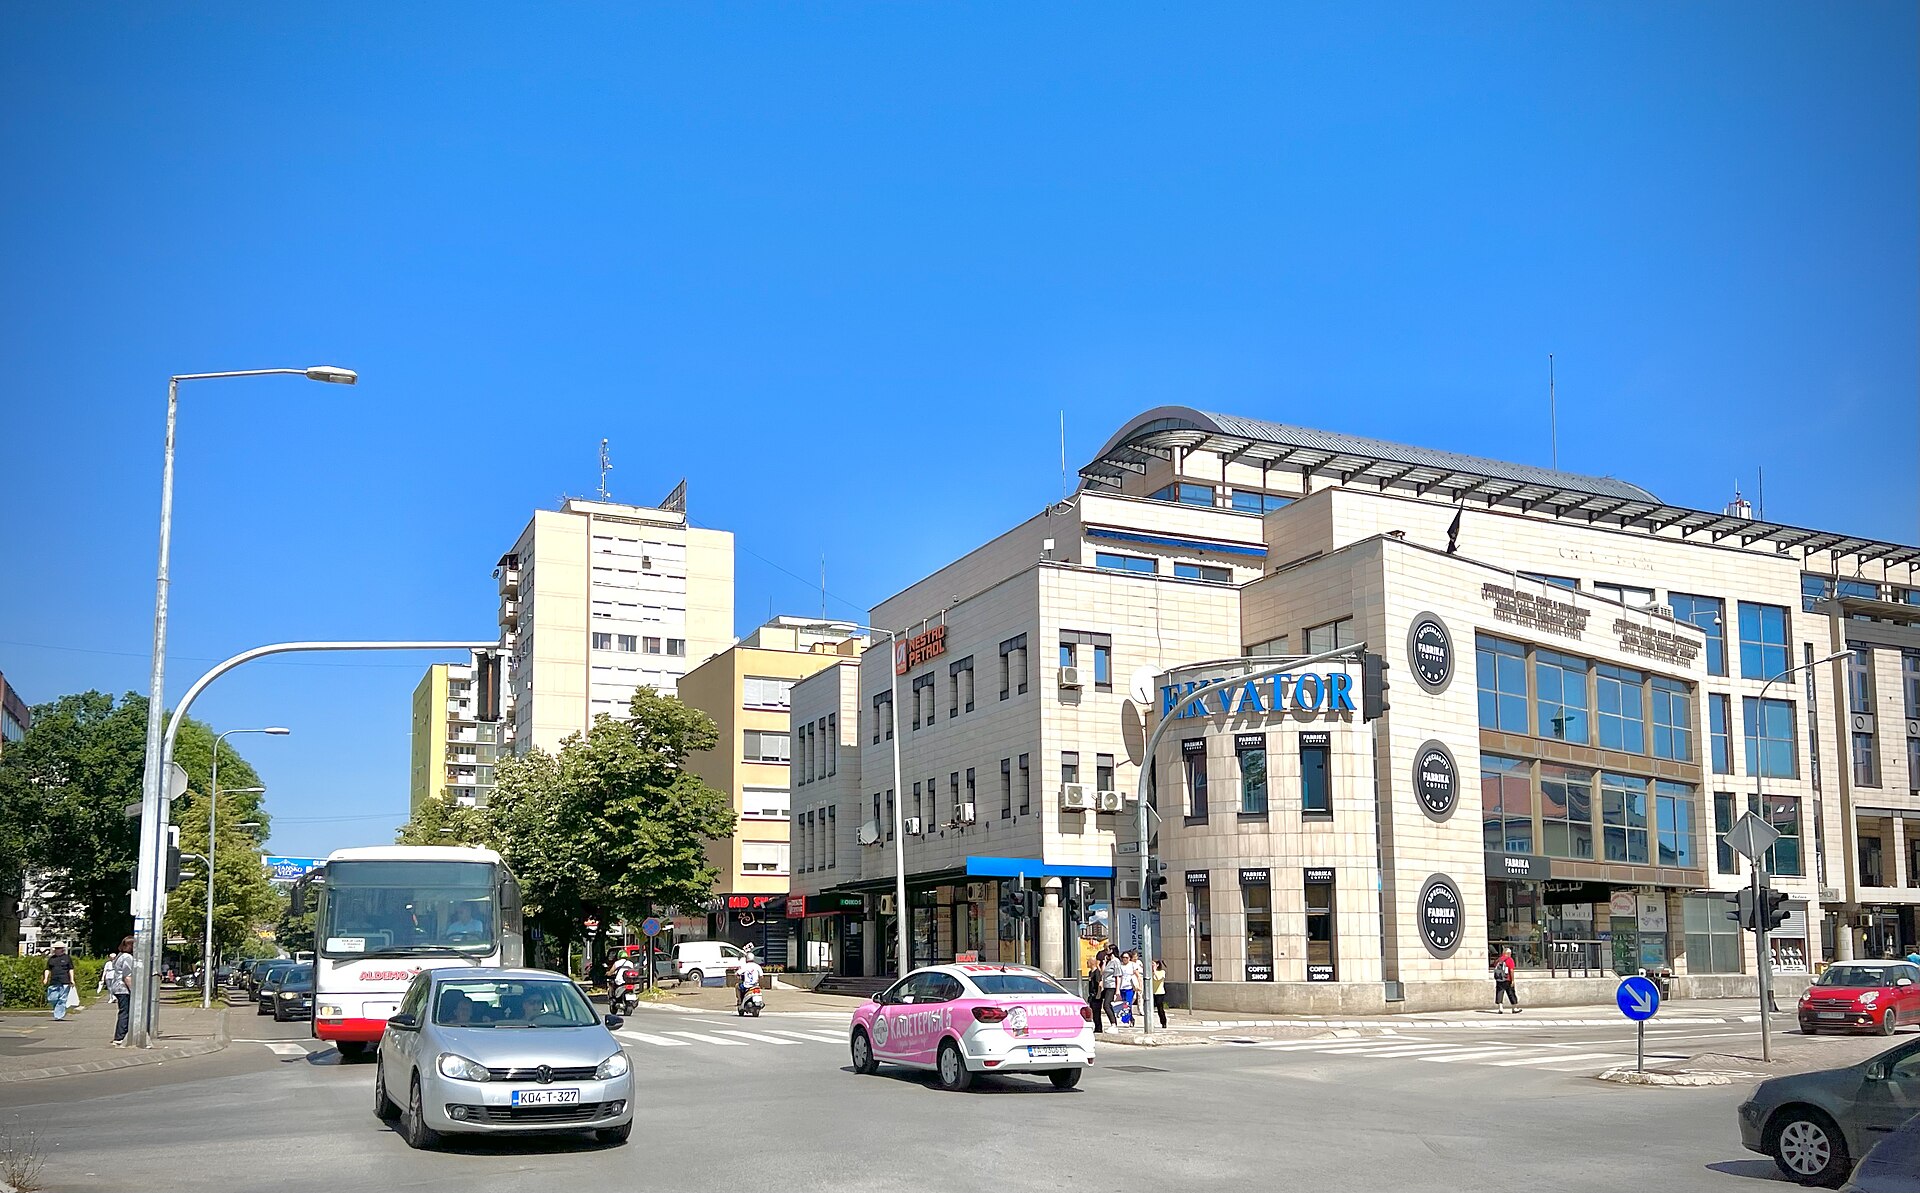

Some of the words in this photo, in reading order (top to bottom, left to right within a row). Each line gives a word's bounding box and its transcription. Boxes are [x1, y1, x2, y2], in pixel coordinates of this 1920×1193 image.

[909, 624, 944, 652] NESTRO
[909, 639, 944, 668] PETROL
[1418, 642, 1445, 657] FABRIKA
[1421, 653, 1443, 663] COFFEE
[1160, 672, 1358, 721] EKVATOR
[1423, 772, 1450, 783] FABRIKA
[1504, 857, 1530, 869] FABRIKA
[728, 896, 749, 908] MD
[1427, 908, 1455, 918] FABRIKA
[360, 971, 408, 981] ALDEMO
[1028, 1005, 1074, 1016] КАФЕТЕРИЈА
[890, 1008, 943, 1040] КАФЕТЕРИЈА
[946, 1007, 954, 1028] 5
[521, 1091, 577, 1103] K04-T-327
